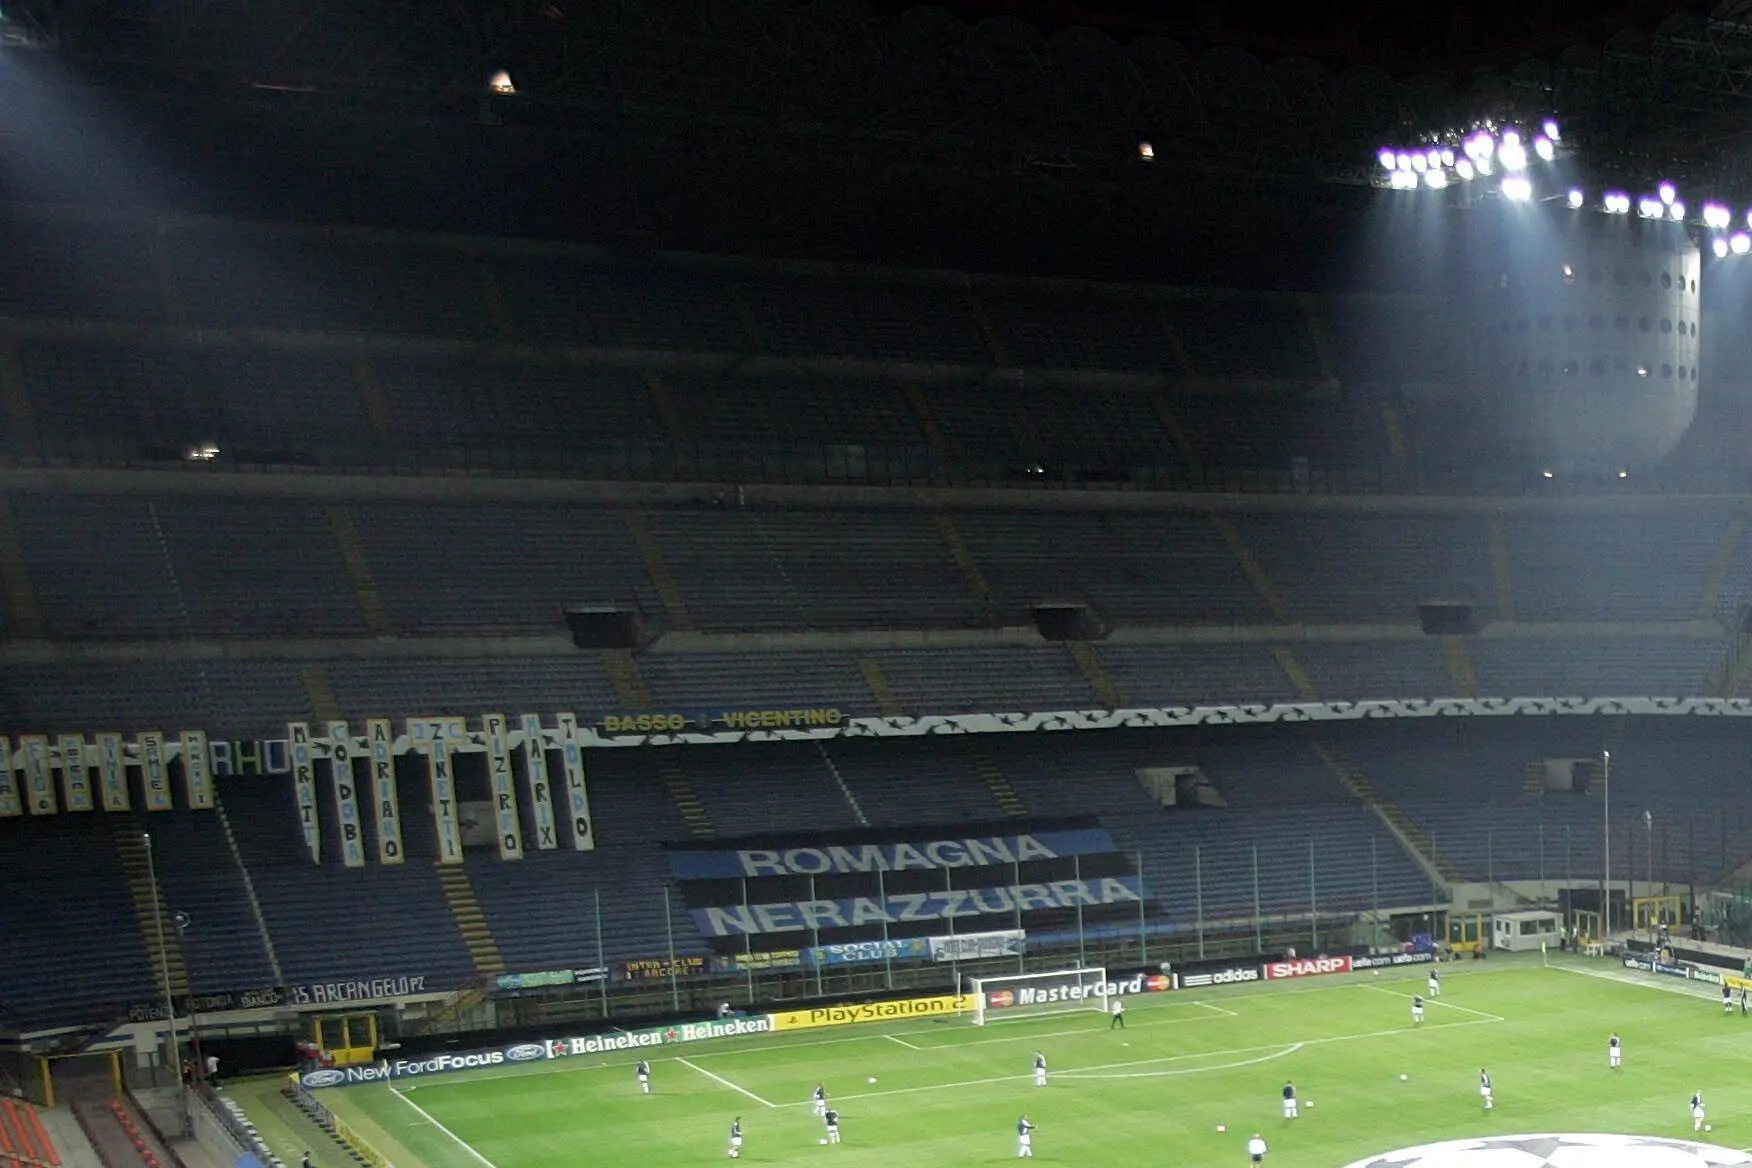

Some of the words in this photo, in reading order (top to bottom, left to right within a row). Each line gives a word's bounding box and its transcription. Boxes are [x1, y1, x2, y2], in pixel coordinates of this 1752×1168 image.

[604, 714, 685, 731] BASSO
[723, 708, 841, 728] VICENTINO
[293, 726, 313, 843] MORATT
[375, 724, 398, 857] ADRIANO
[525, 716, 553, 846] MATRIX
[561, 718, 589, 837] TOLDO
[333, 725, 359, 861] CORDOBA
[737, 834, 1058, 877] ROMAGNA
[707, 877, 1142, 936] NERAZZURRA
[843, 947, 898, 961] CLUB
[1213, 970, 1258, 984] adidas
[1273, 959, 1344, 978] SHARP
[313, 977, 409, 1003] ARCANGELO
[1019, 977, 1142, 1005] MasterCard
[811, 1000, 944, 1025] PlayStation
[952, 996, 967, 1010] 2
[572, 1028, 662, 1054] Heineken
[681, 1018, 768, 1041] Heineken
[347, 1064, 391, 1082] New
